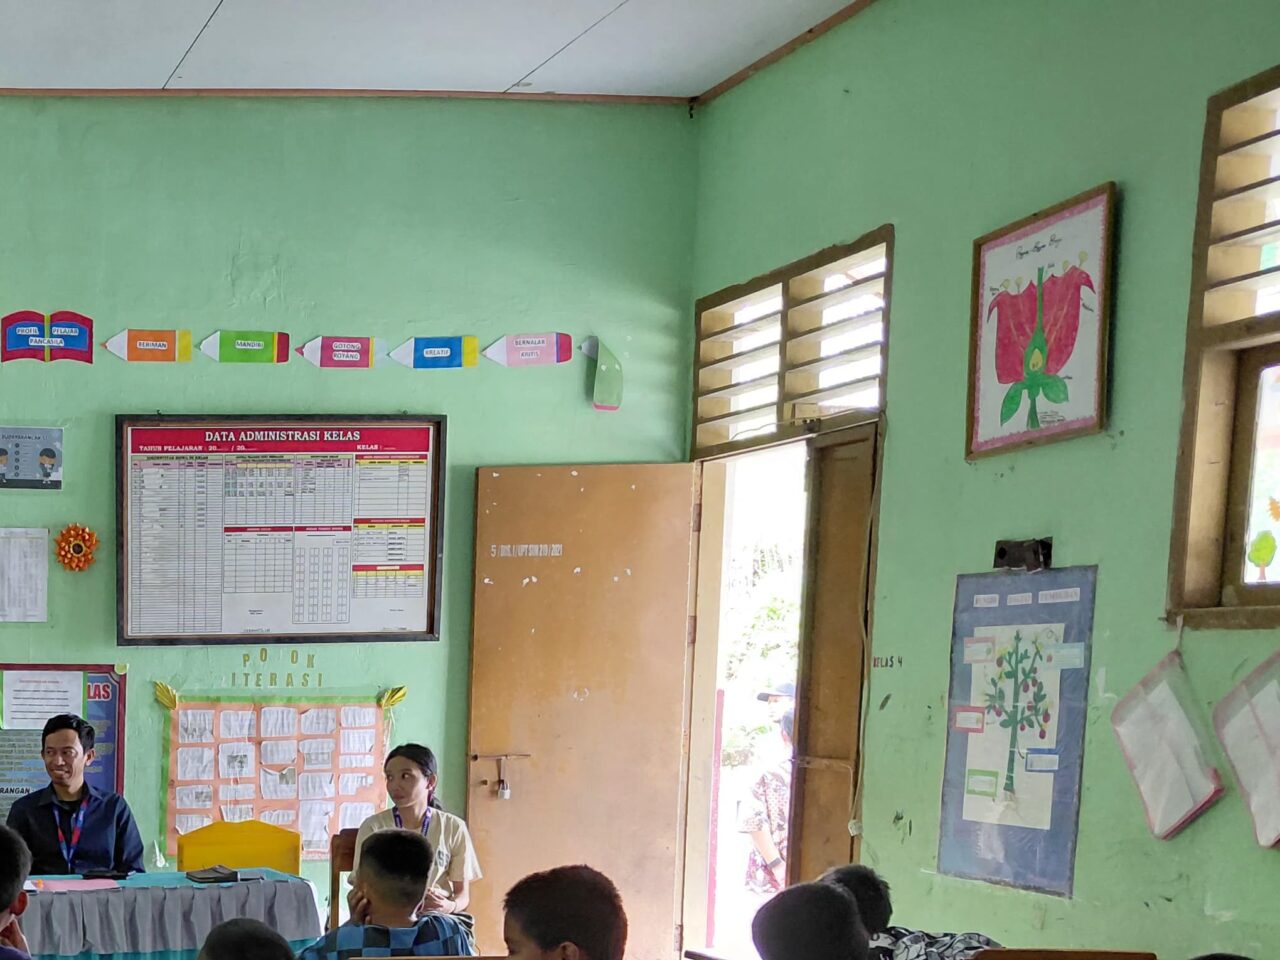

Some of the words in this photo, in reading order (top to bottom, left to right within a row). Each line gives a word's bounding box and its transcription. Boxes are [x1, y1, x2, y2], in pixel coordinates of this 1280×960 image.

[205, 431, 235, 442] DATA
[239, 430, 320, 442] ADMINISTRASI
[324, 430, 361, 441] KELAS
